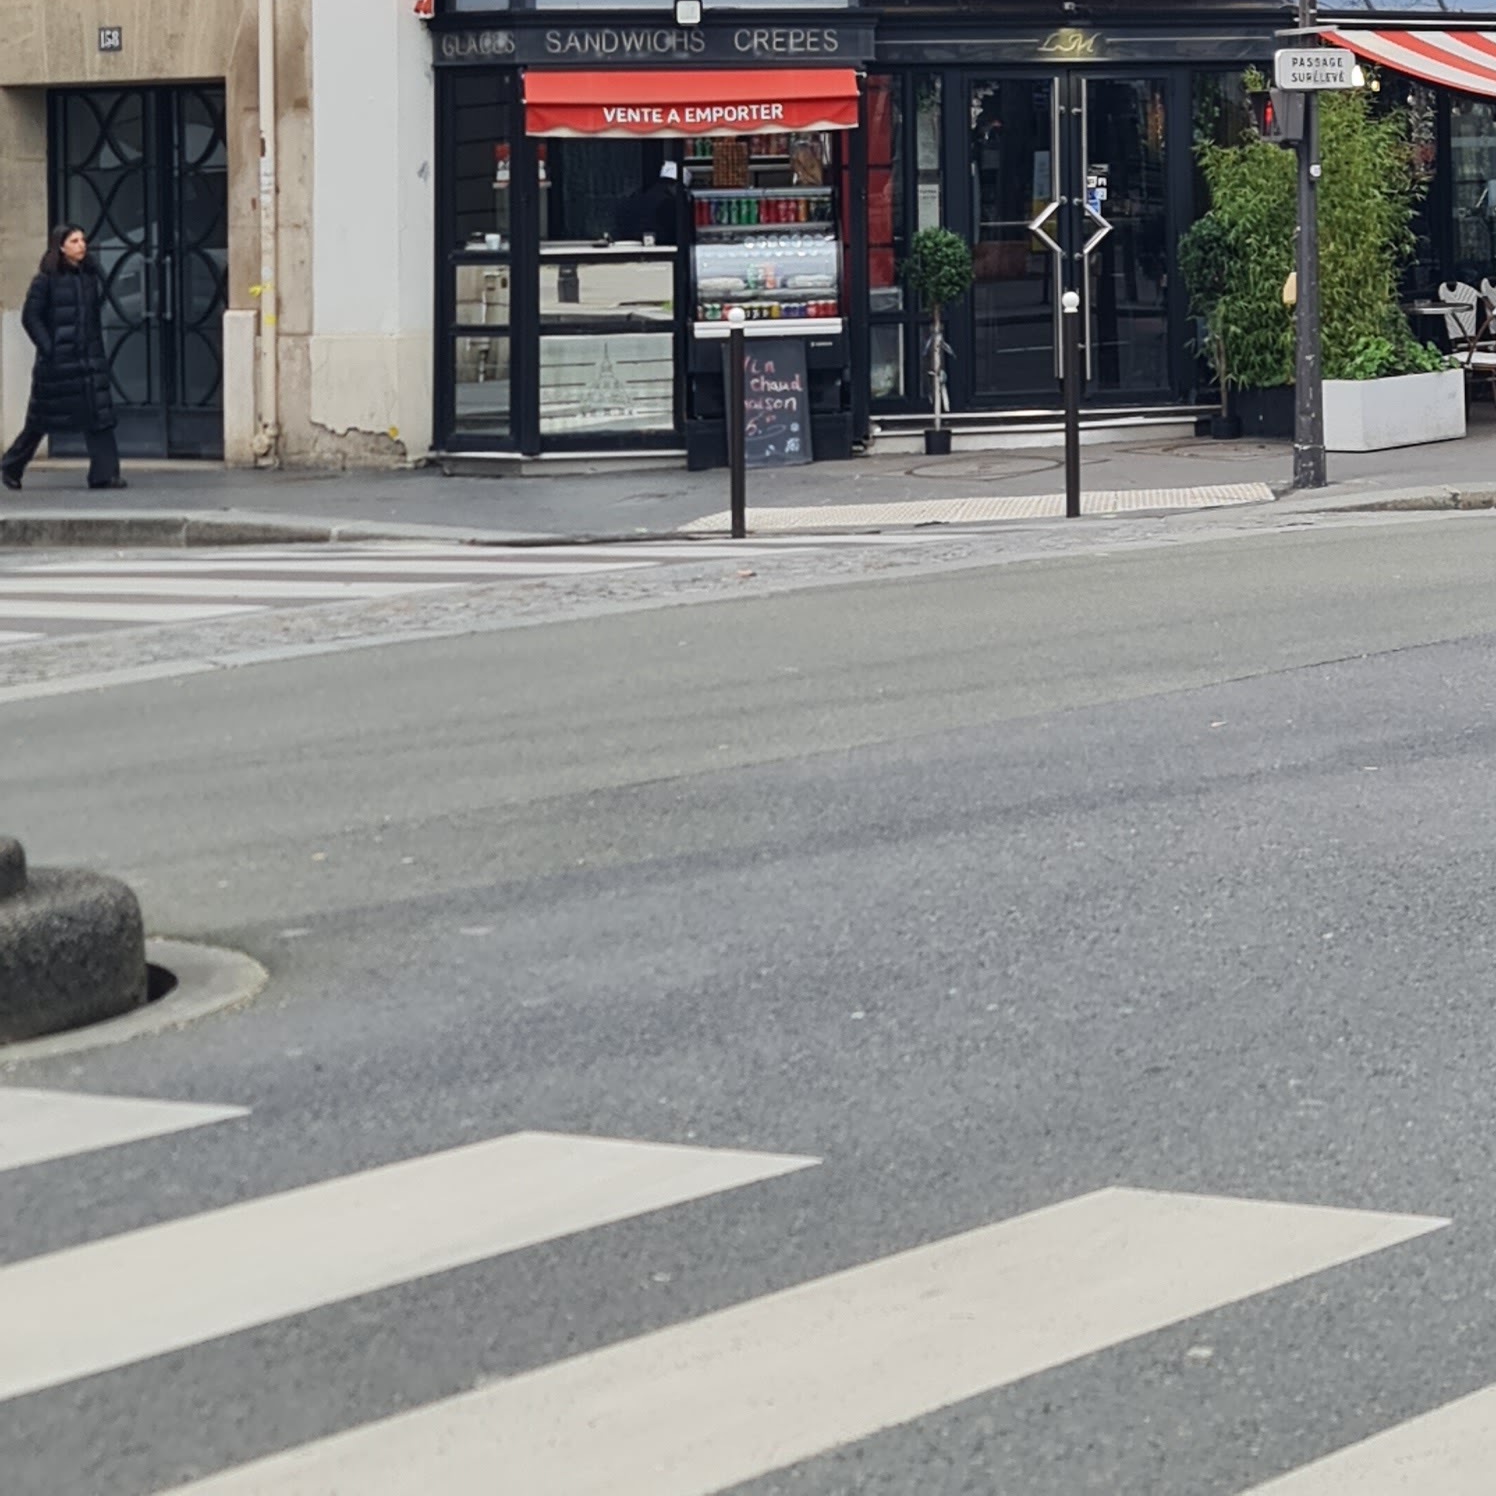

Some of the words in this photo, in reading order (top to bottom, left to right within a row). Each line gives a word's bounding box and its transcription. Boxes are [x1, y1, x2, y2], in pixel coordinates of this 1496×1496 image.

[546, 29, 706, 54] SANDWICHS
[1291, 57, 1343, 68] PASSAGE
[603, 107, 664, 124] VENTE
[668, 108, 681, 123] A
[685, 104, 784, 123] EMPORTER
